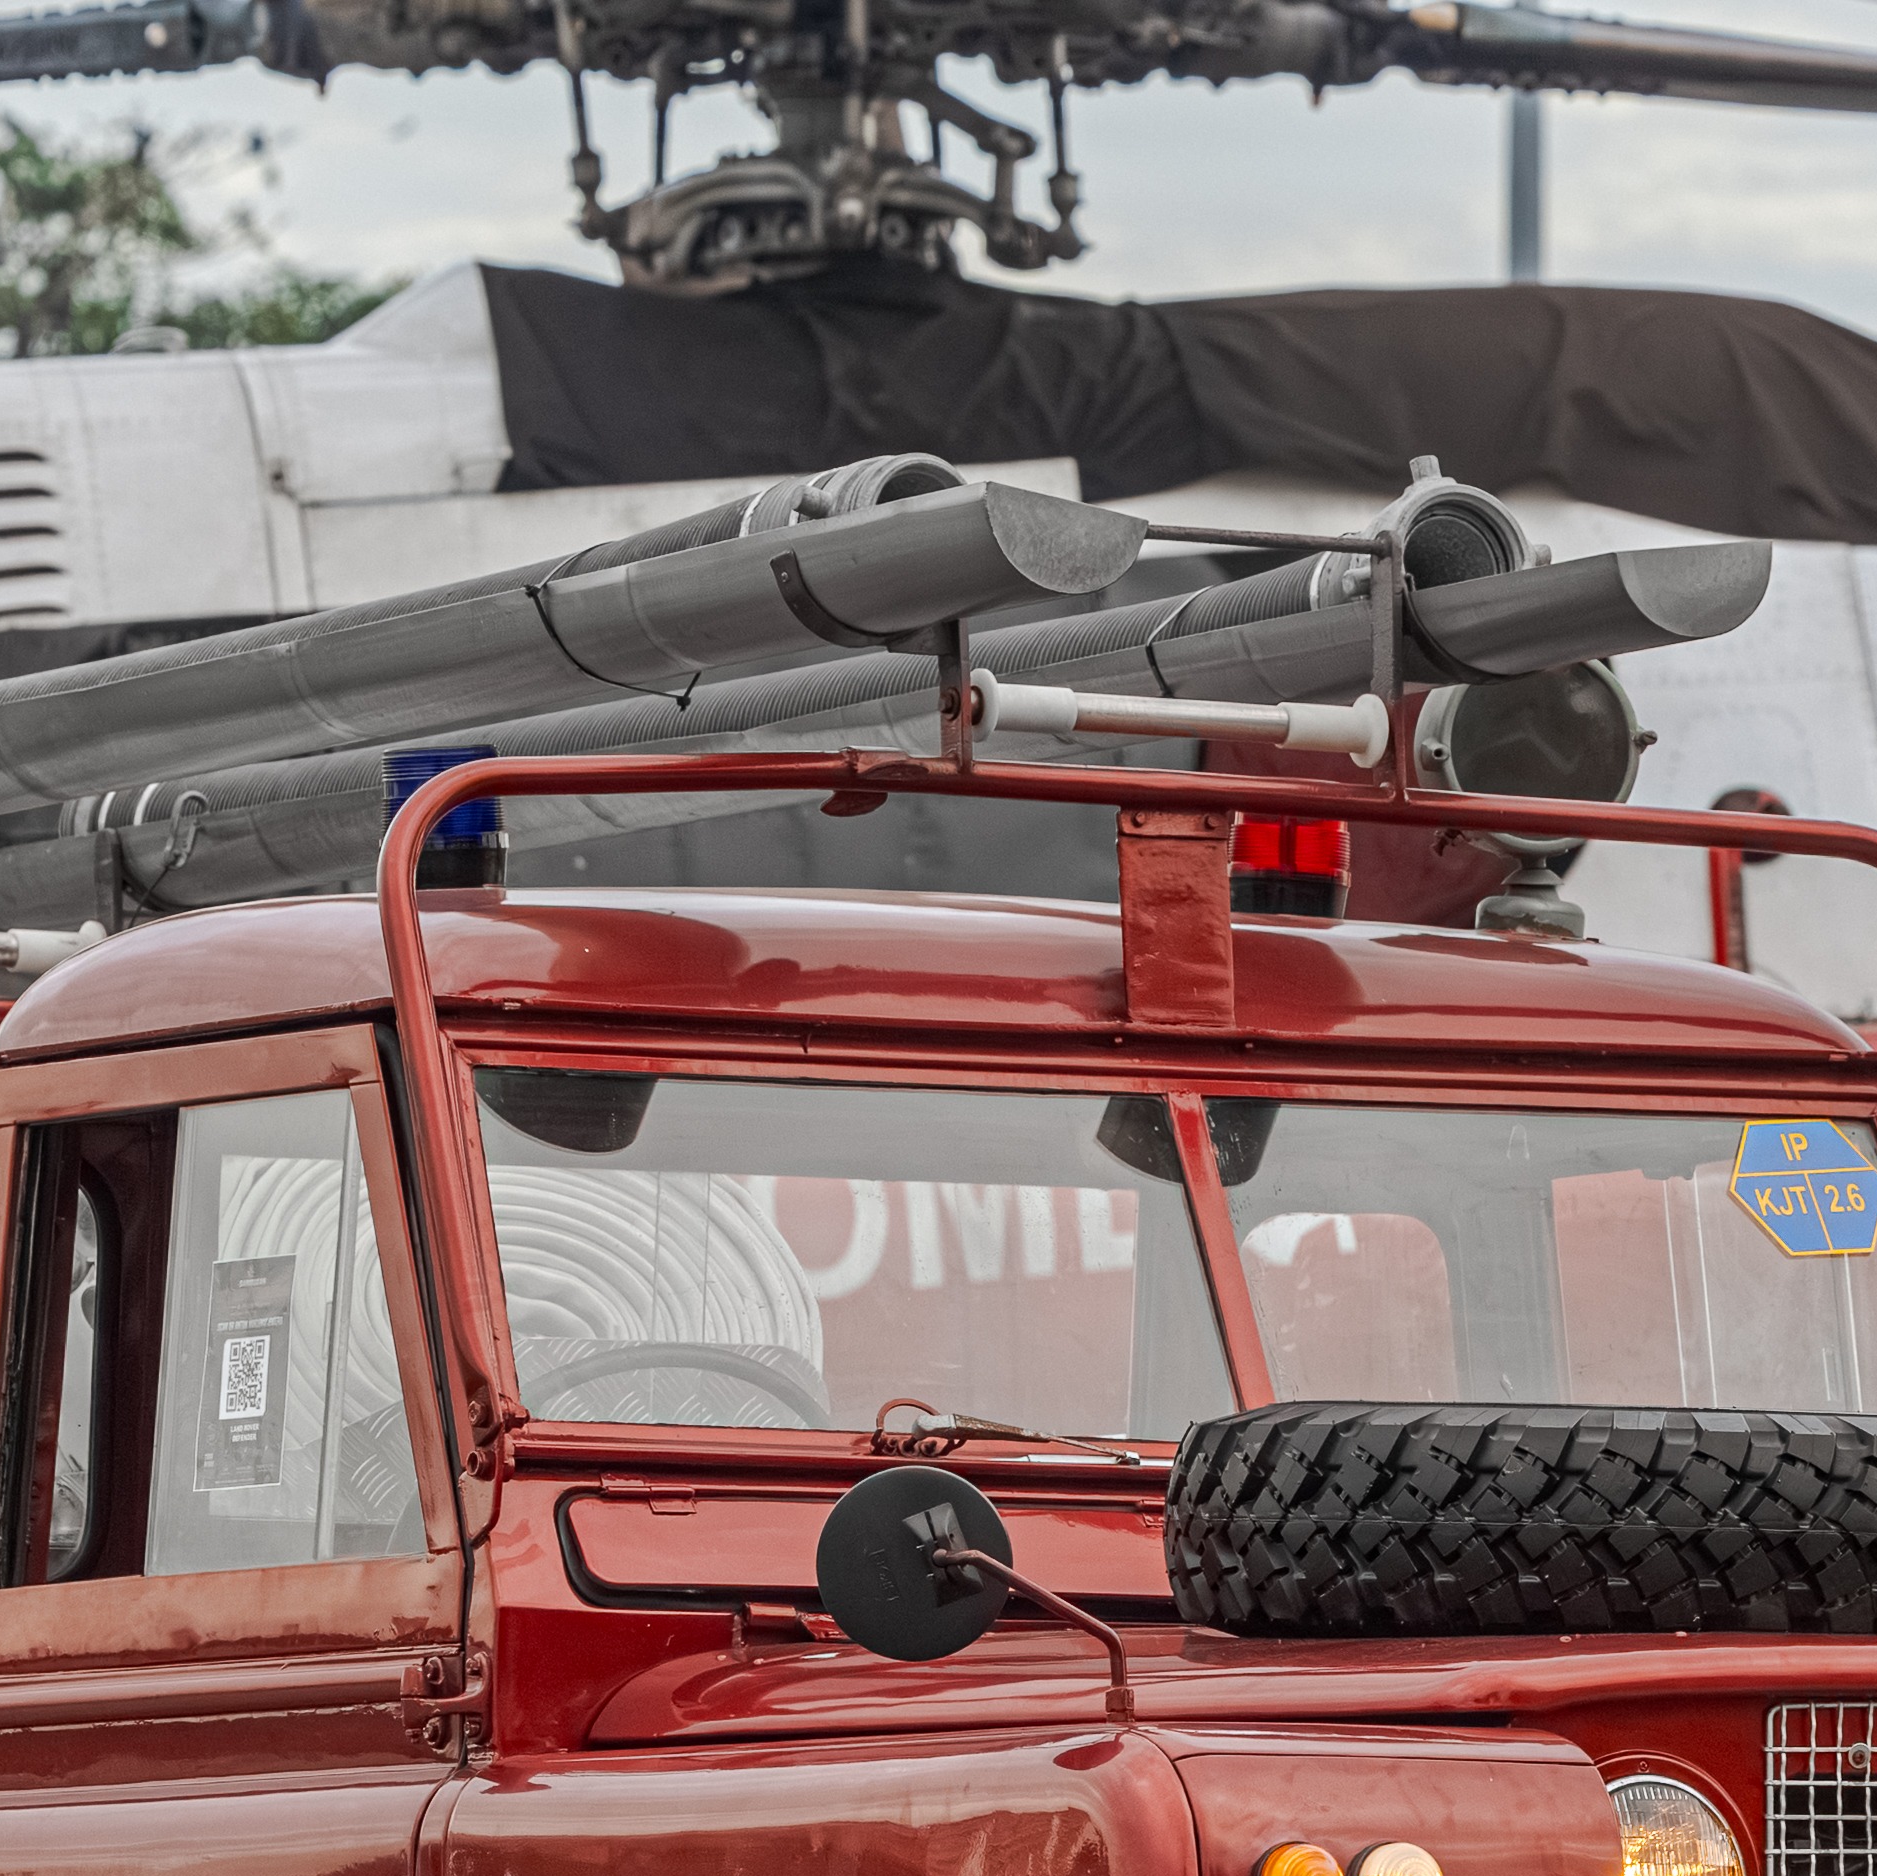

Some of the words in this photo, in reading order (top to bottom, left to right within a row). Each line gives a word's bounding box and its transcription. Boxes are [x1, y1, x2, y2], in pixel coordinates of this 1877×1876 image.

[1780, 1132, 1809, 1161] IP
[1754, 1186, 1809, 1217] KJT
[1824, 1183, 1866, 1213] 2.6
